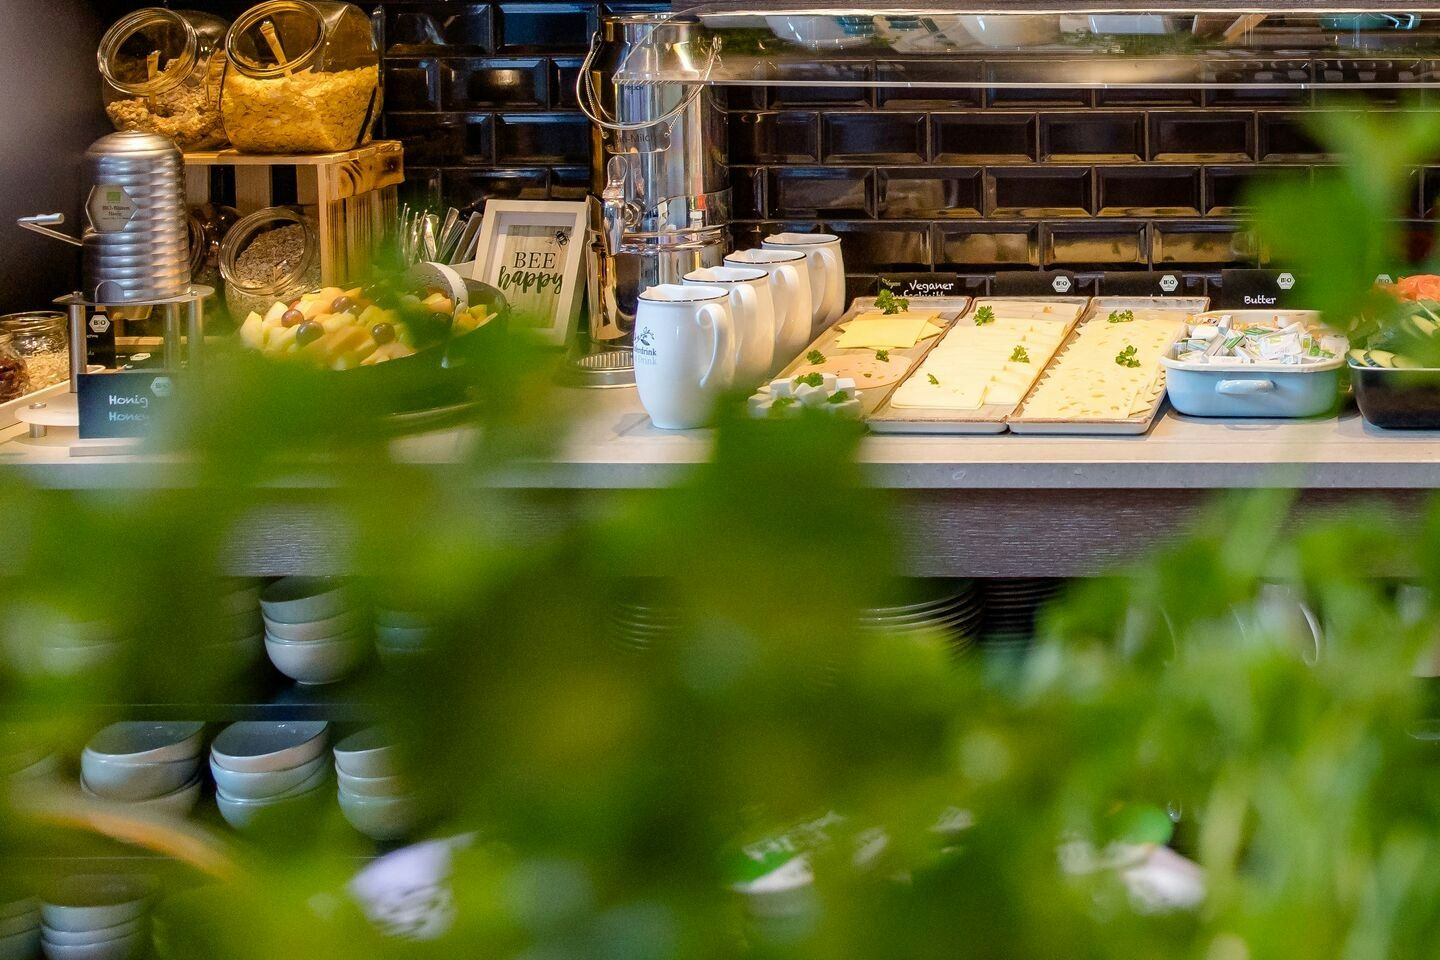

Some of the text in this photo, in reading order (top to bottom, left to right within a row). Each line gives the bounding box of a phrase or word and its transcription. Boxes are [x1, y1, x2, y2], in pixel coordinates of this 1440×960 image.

[513, 252, 556, 269] BEE
[497, 266, 563, 294] happy
[909, 279, 955, 293] Veganer
[1244, 295, 1277, 305] Butter
[109, 395, 148, 408] Honig
[109, 411, 149, 423] Hone
